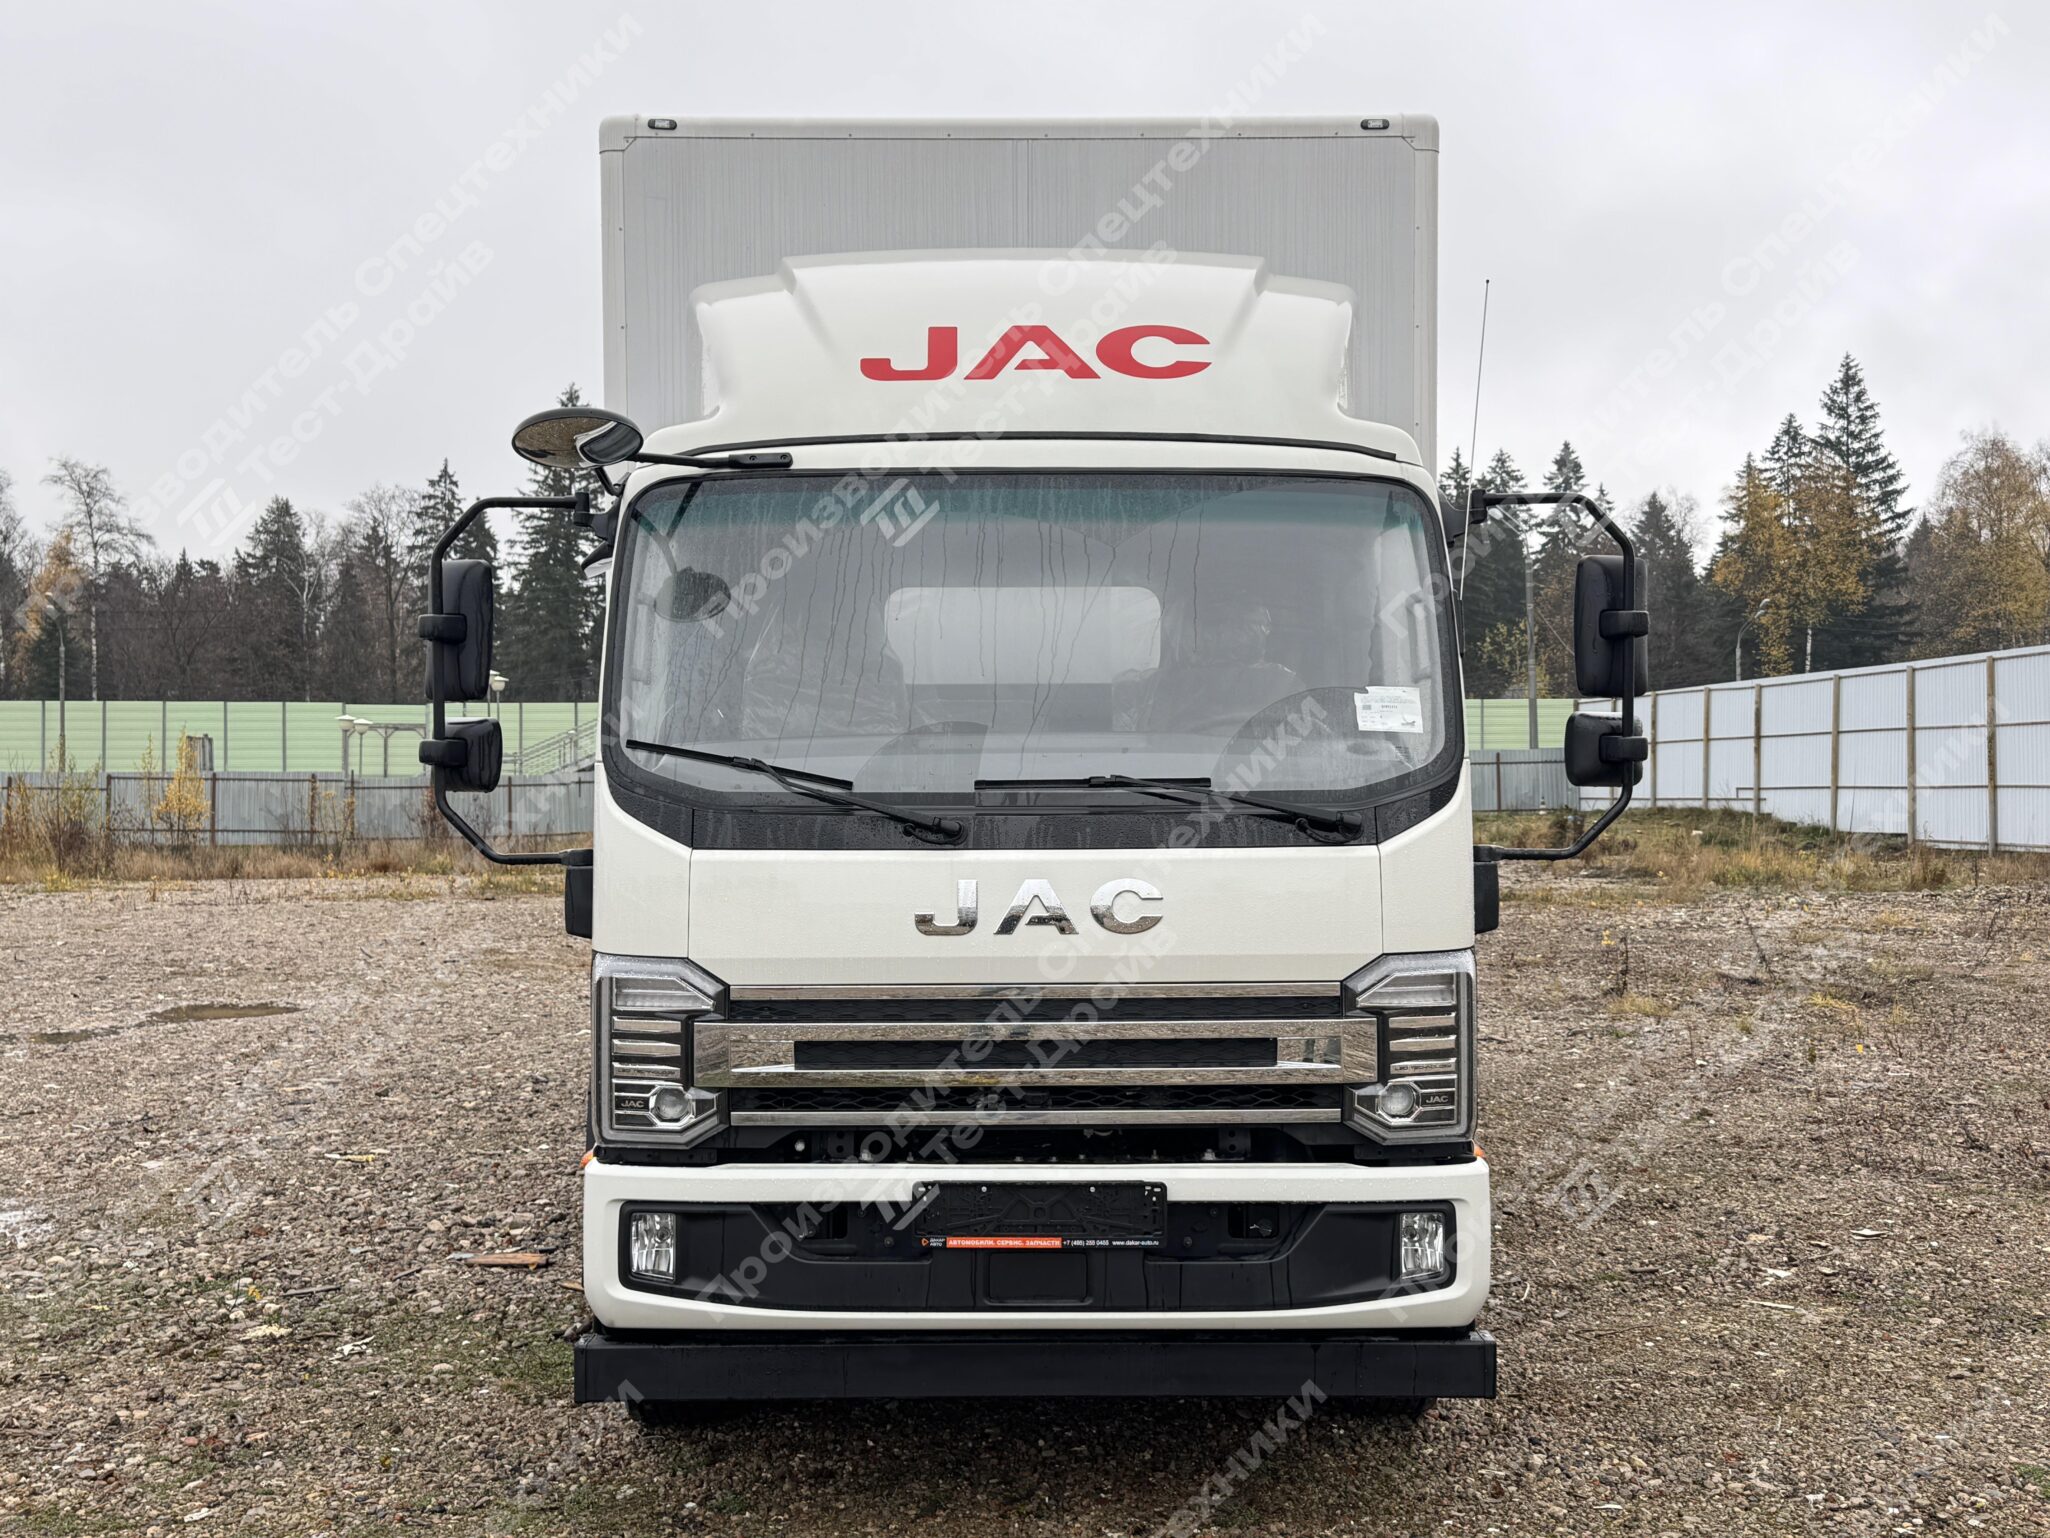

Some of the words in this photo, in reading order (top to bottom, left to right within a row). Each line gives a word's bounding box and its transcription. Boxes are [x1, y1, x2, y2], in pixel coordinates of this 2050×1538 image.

[860, 324, 1212, 382] JAC
[914, 878, 1164, 936] JAC
[621, 1100, 644, 1108] JAC
[1425, 1095, 1449, 1104] JAC
